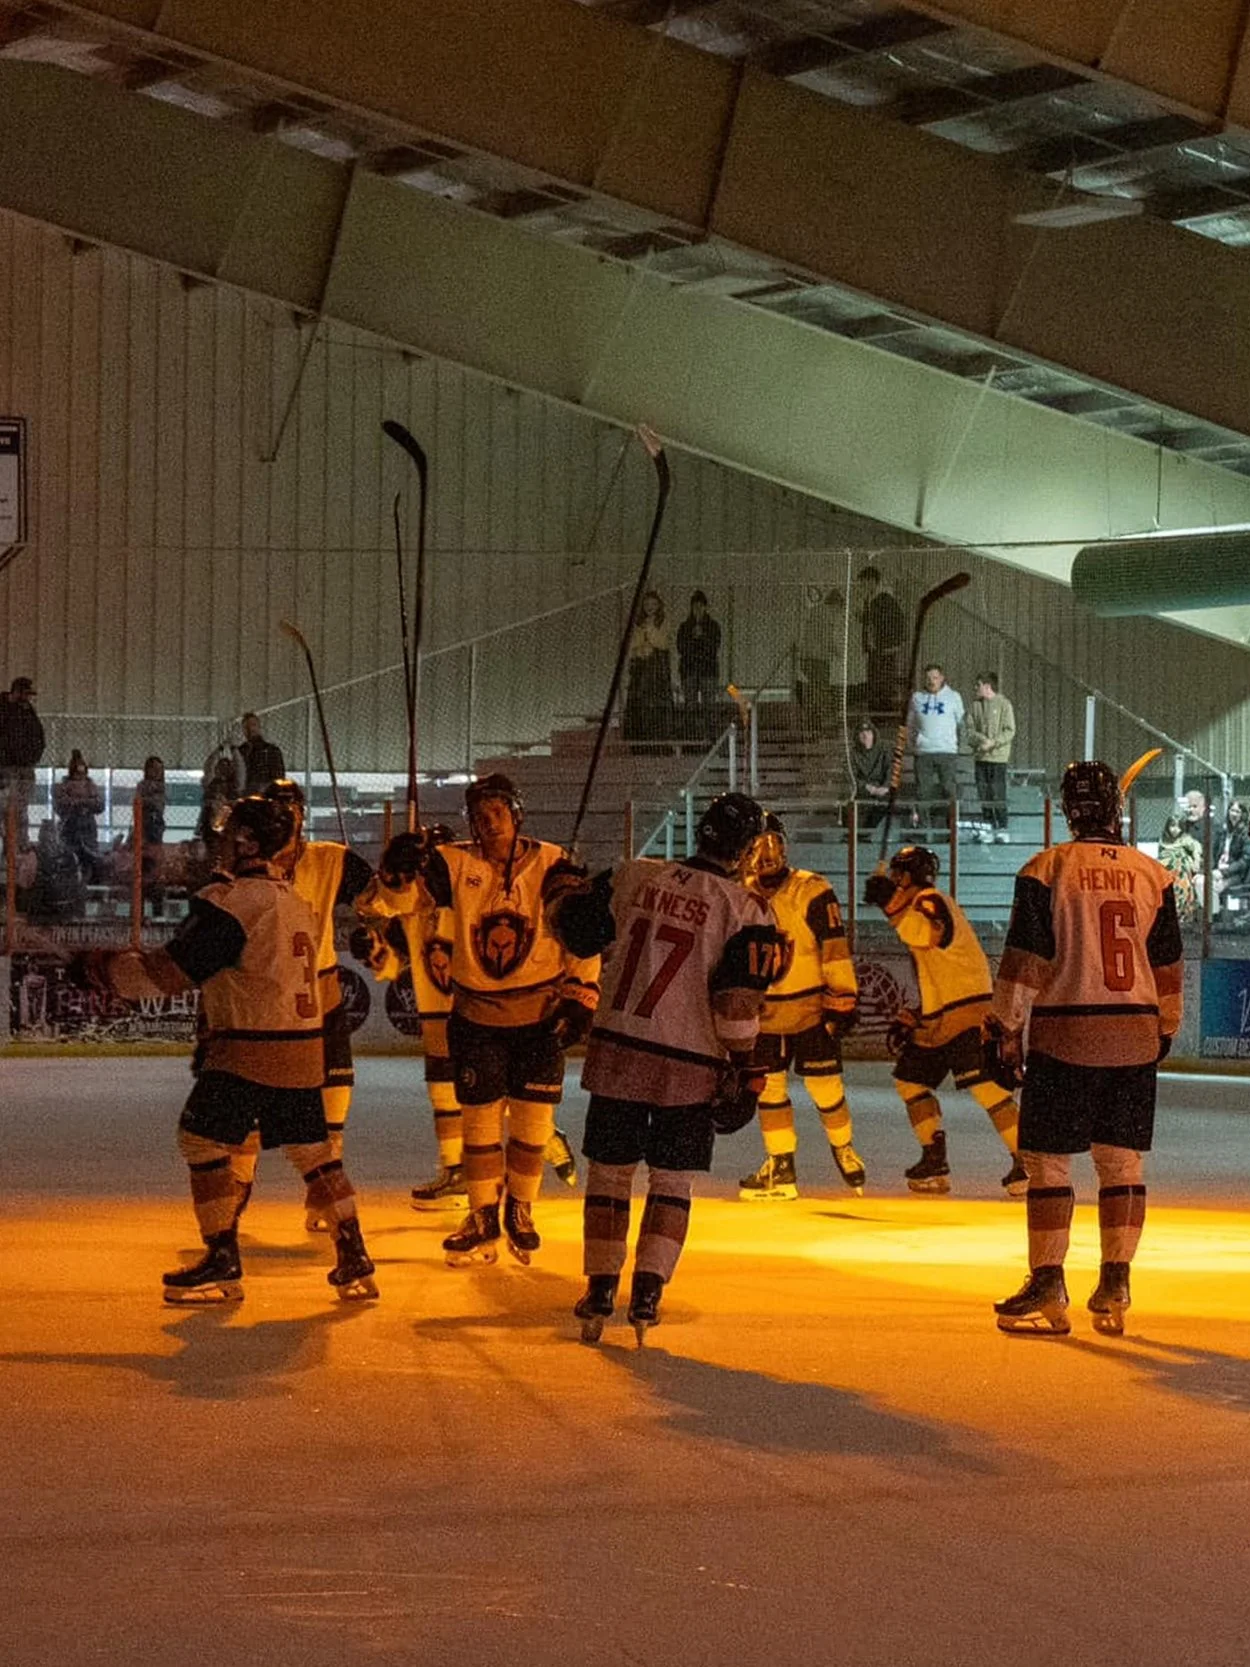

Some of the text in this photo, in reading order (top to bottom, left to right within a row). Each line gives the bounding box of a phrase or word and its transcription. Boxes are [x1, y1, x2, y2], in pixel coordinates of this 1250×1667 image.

[1079, 868, 1137, 894] HENRY
[293, 932, 318, 1018] 3
[610, 917, 695, 1019] 17
[1100, 900, 1135, 991] 6
